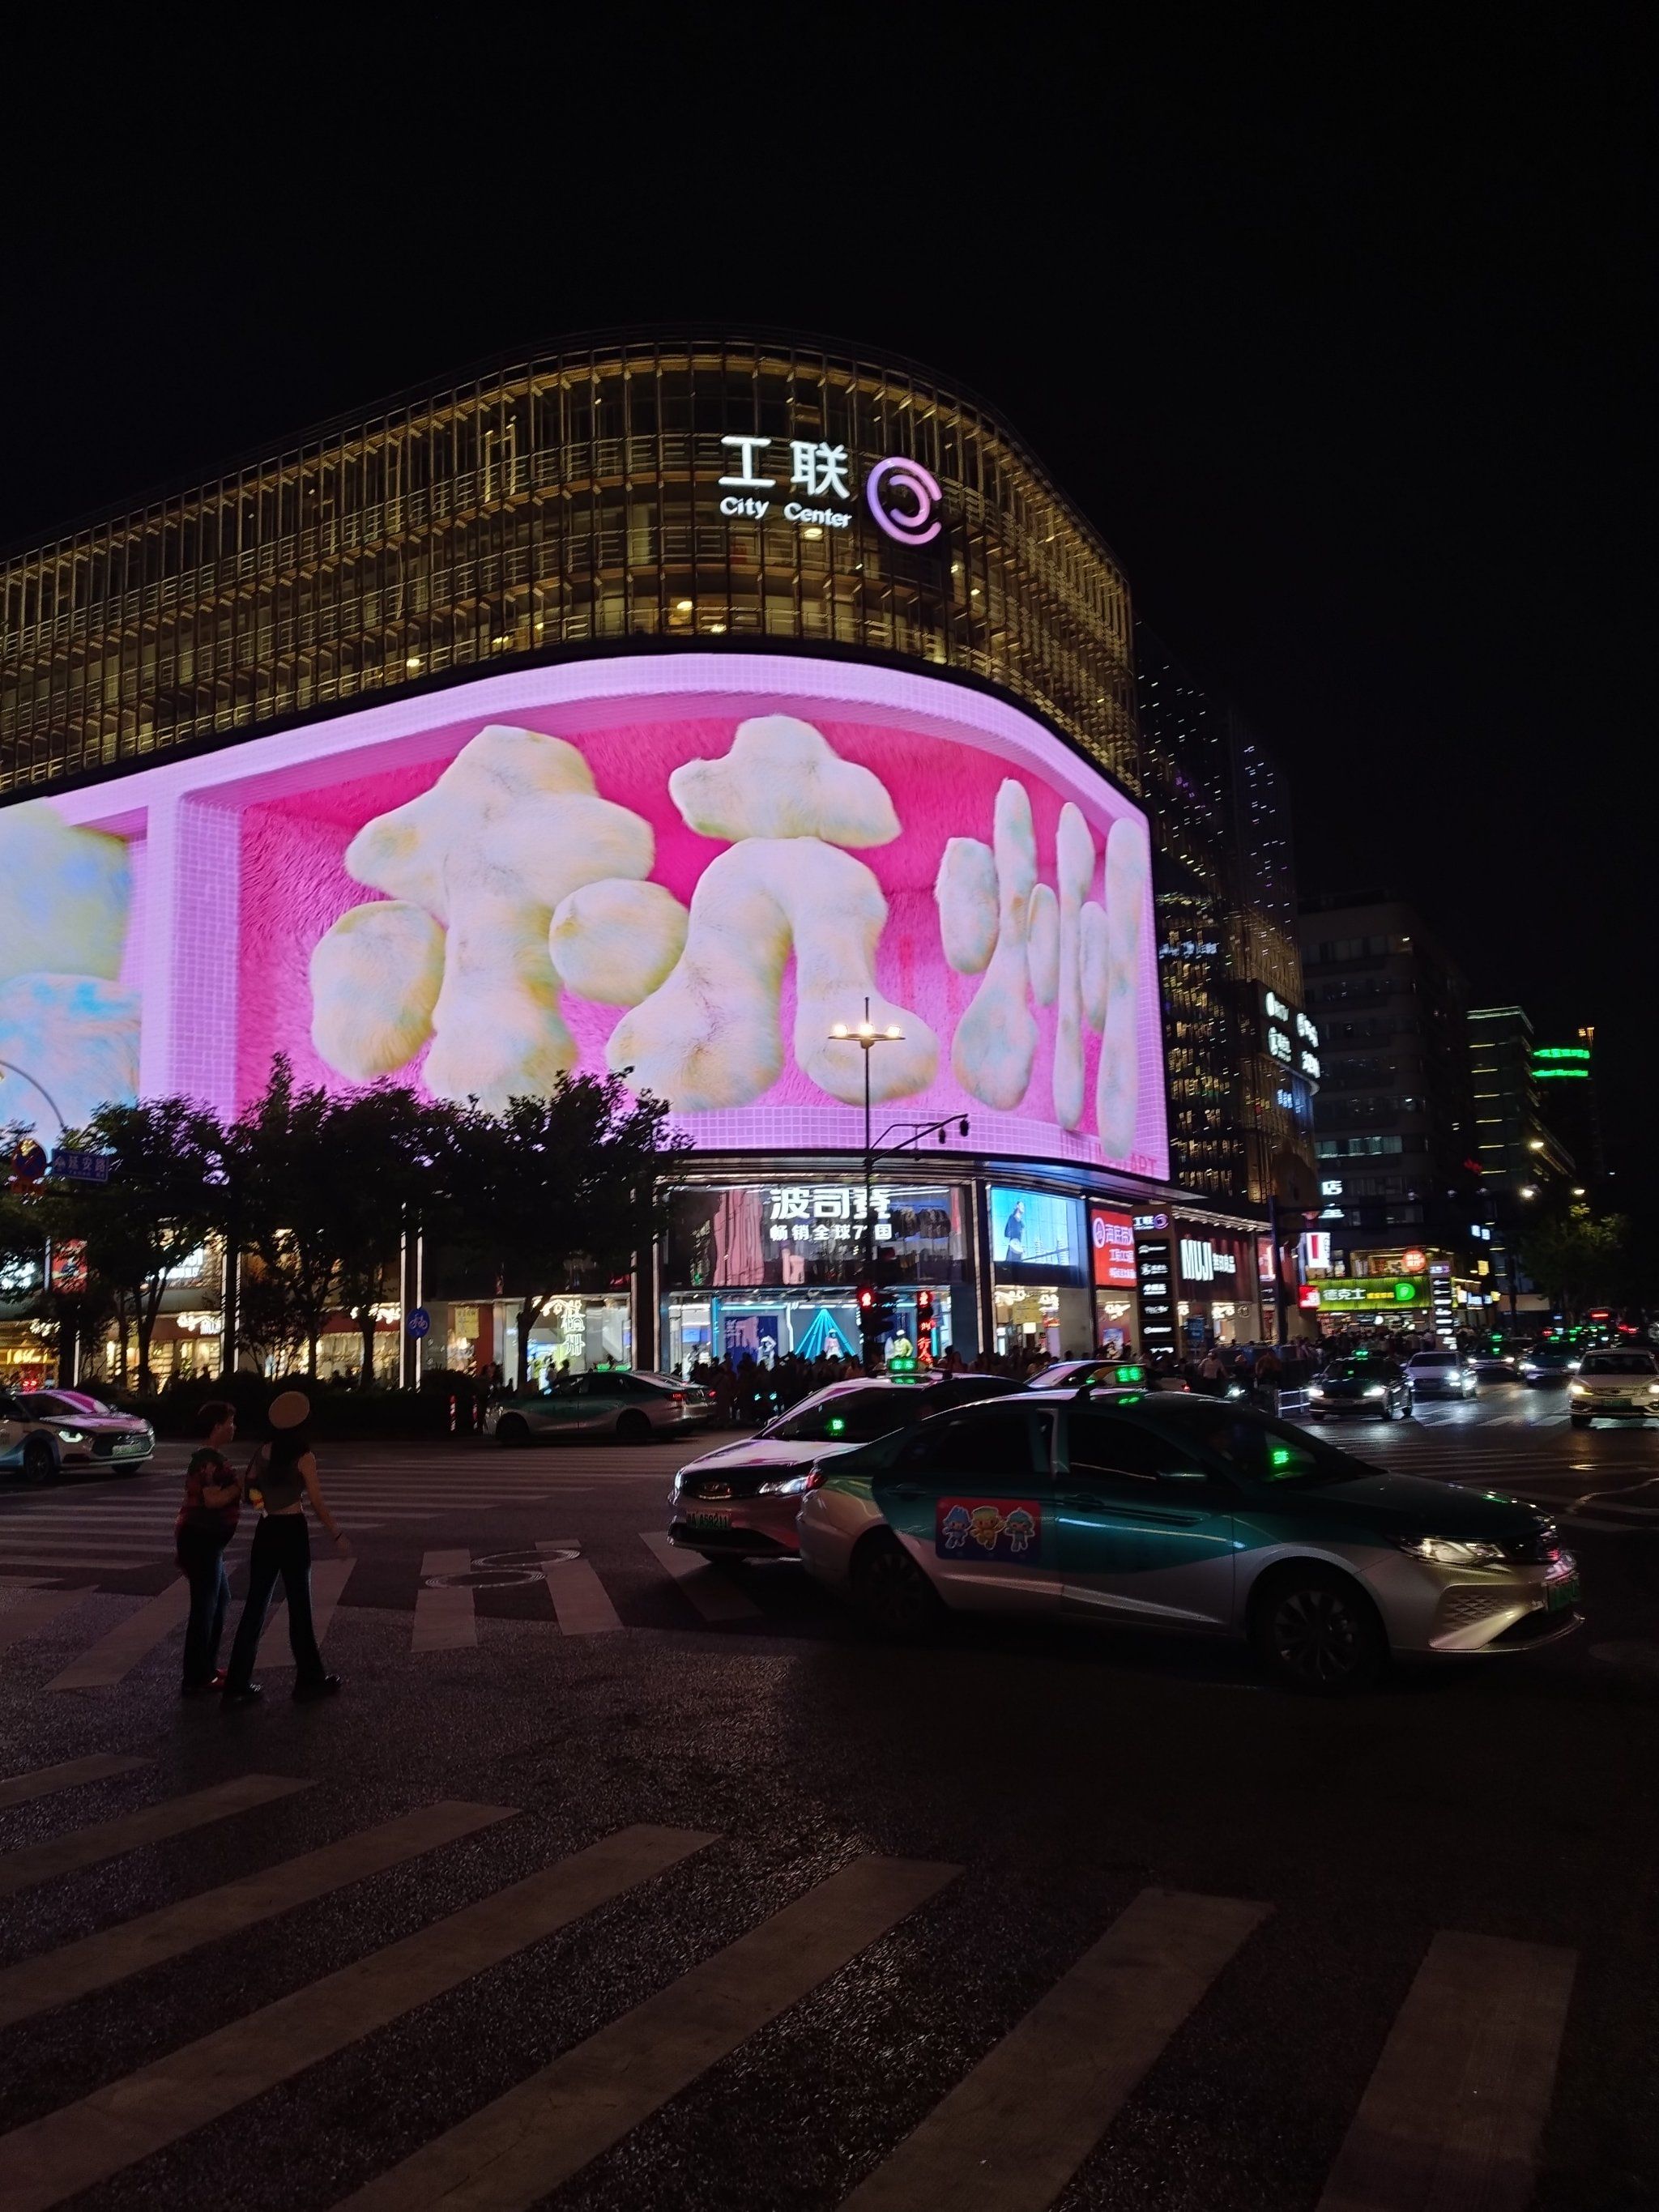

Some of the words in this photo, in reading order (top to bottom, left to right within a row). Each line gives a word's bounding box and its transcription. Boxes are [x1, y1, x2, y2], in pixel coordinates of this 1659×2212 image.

[719, 436, 851, 499] 工联
[719, 496, 770, 519] City
[783, 502, 852, 529] Center
[770, 1188, 891, 1220] 波司登
[770, 1224, 892, 1241] 畅销全球7国
[1180, 1239, 1214, 1281] MUJI
